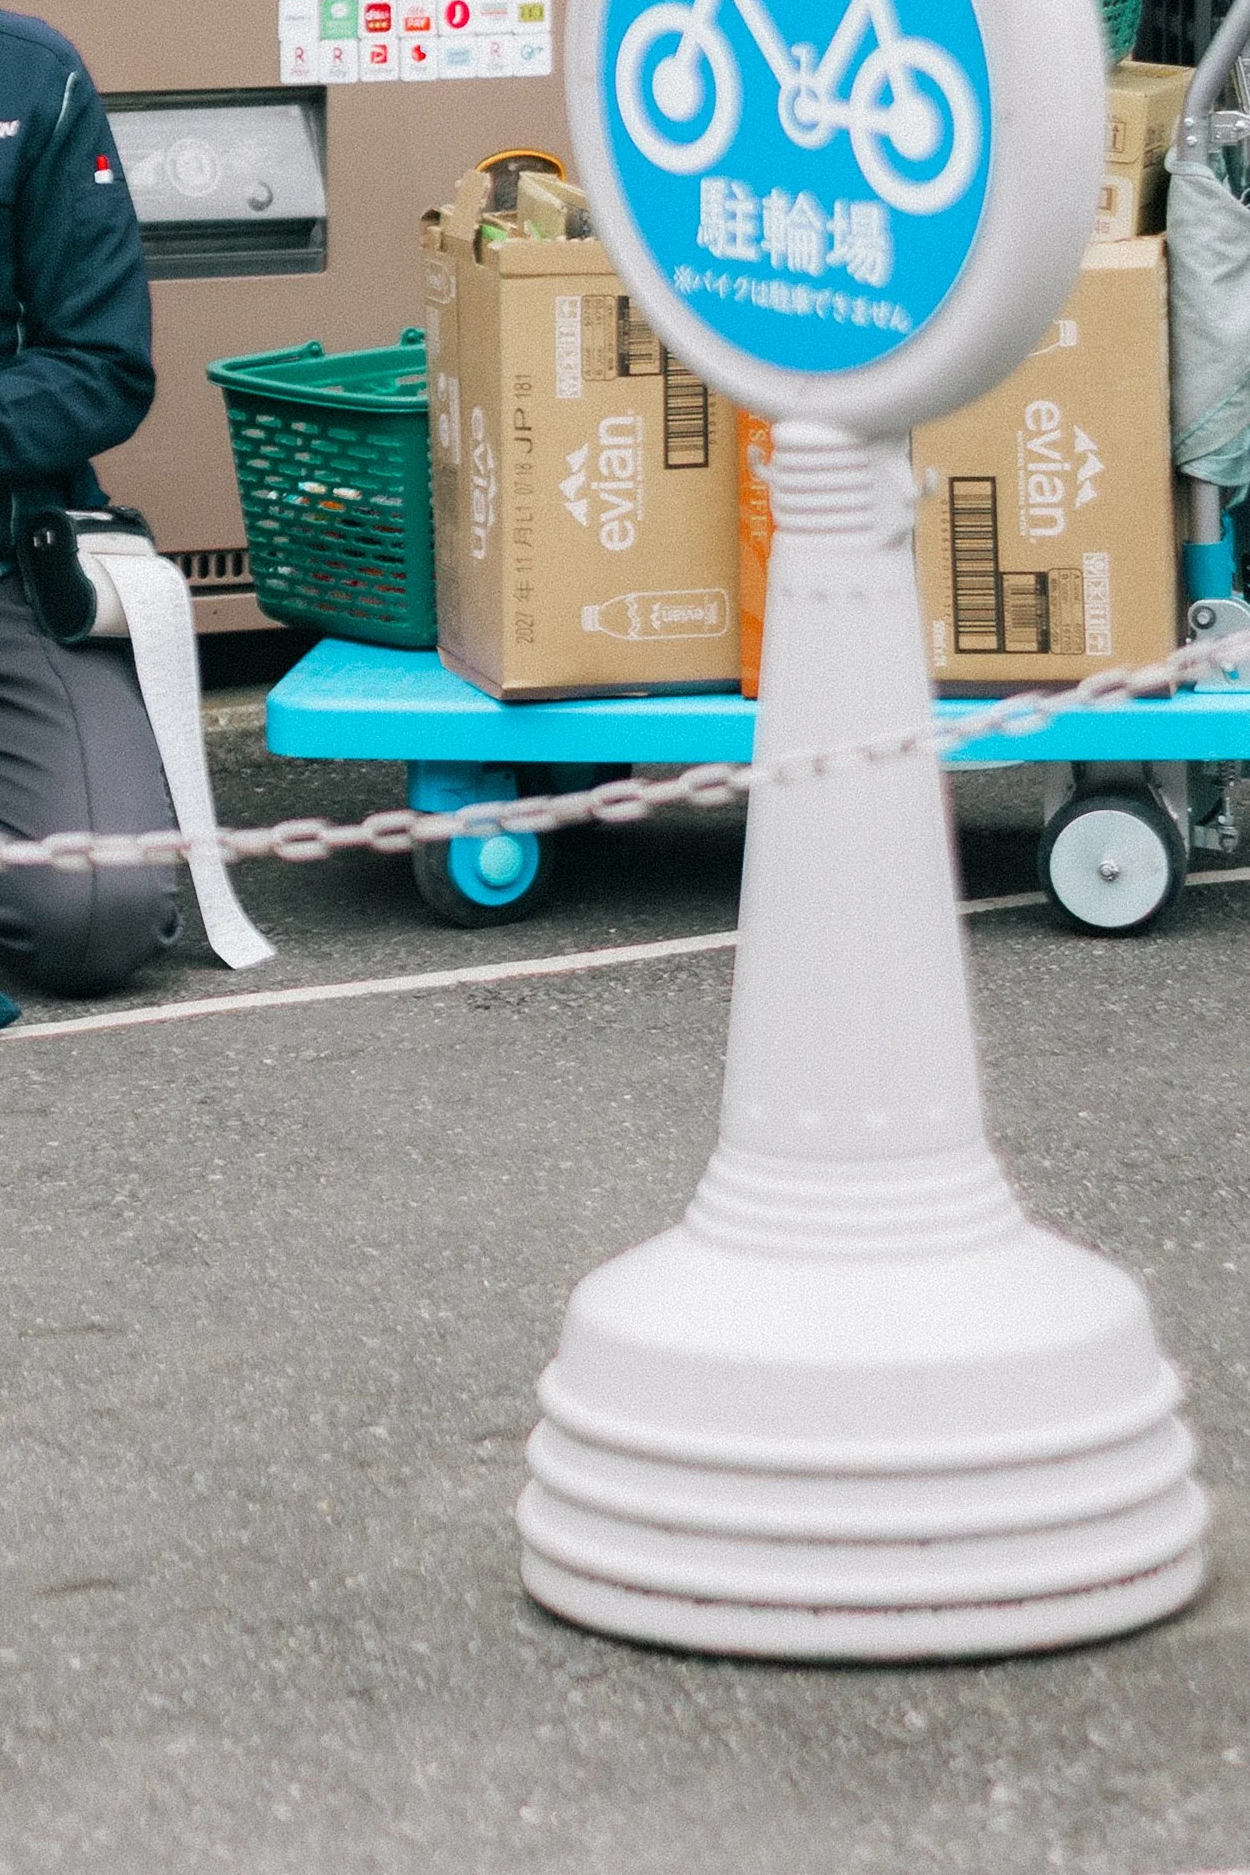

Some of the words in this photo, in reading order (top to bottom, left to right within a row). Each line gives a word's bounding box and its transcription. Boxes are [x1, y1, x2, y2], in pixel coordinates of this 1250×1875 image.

[696, 175, 895, 289] 駐輪場
[470, 405, 491, 561] evian
[513, 407, 535, 455] JP
[591, 410, 636, 552] evian
[1024, 399, 1072, 538] evian
